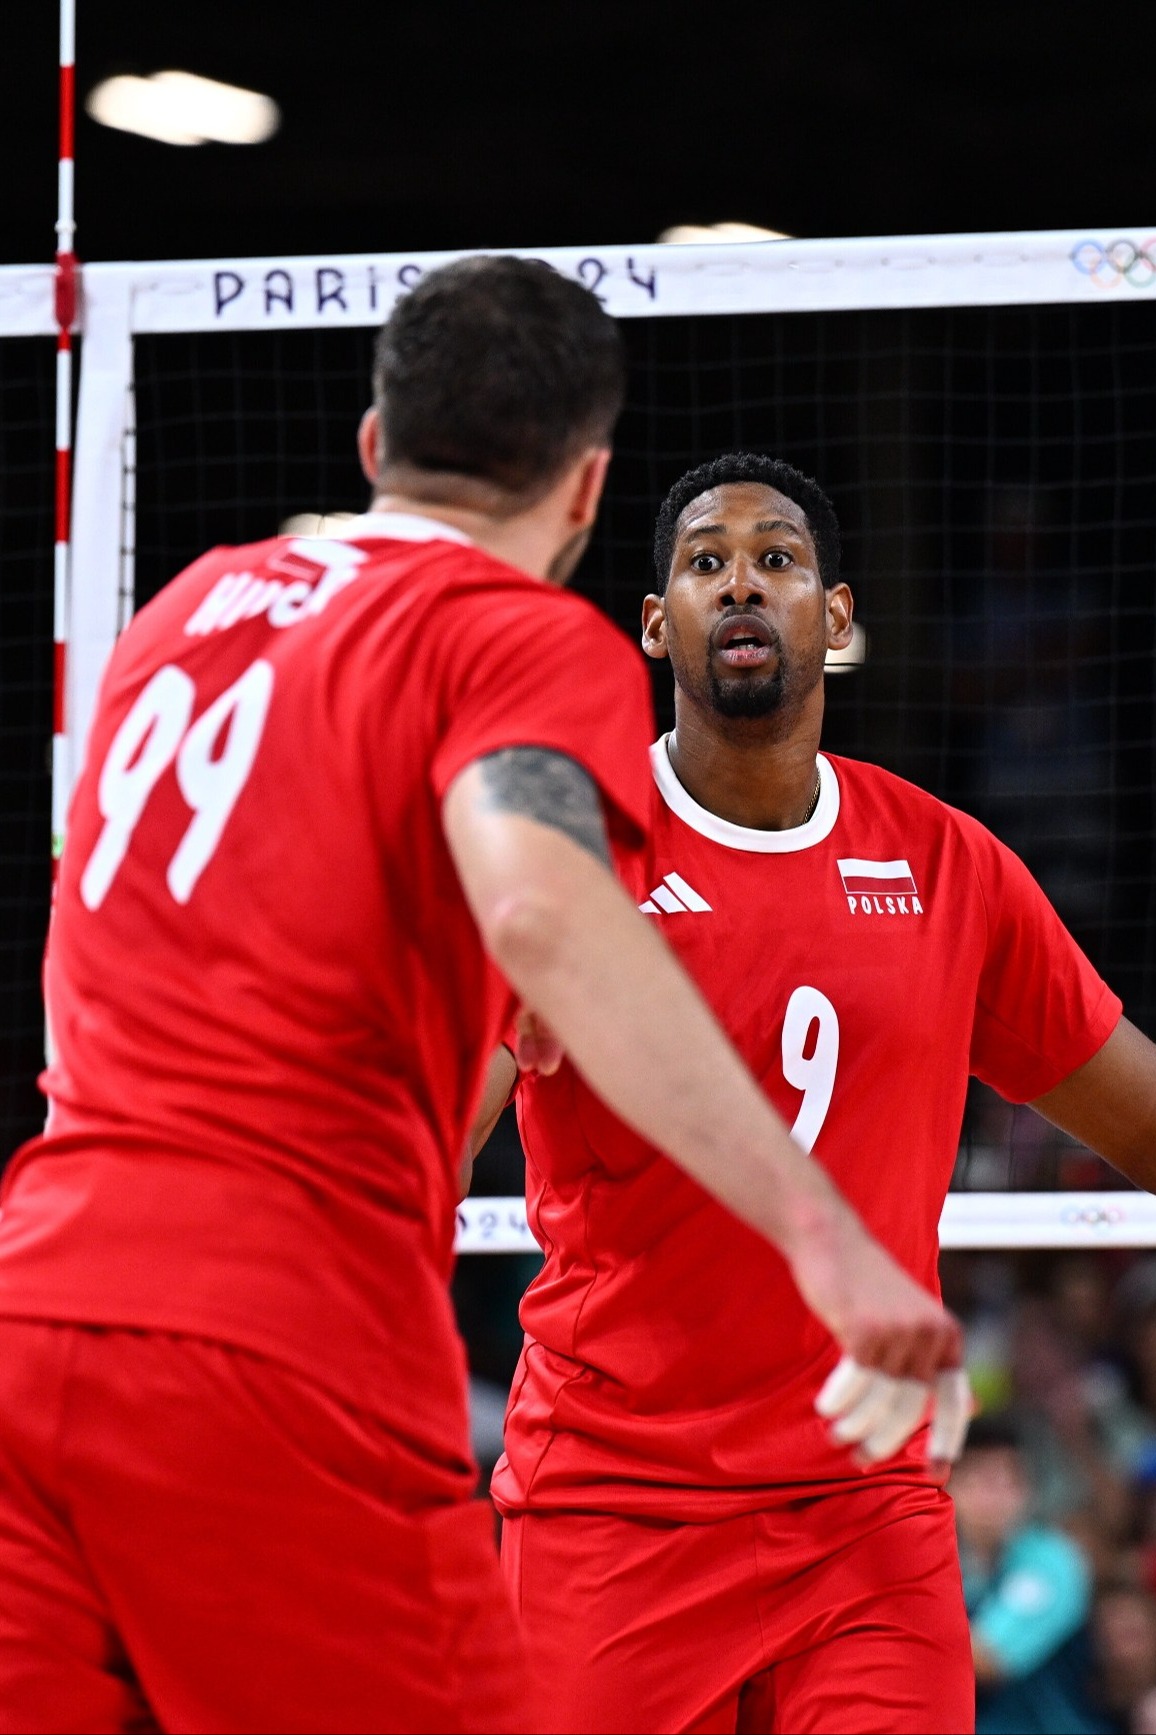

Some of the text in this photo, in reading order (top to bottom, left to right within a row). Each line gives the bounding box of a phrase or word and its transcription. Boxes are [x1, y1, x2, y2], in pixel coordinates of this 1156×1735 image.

[80, 660, 274, 911] 99
[847, 896, 923, 915] POLSKA
[781, 985, 840, 1156] 9
